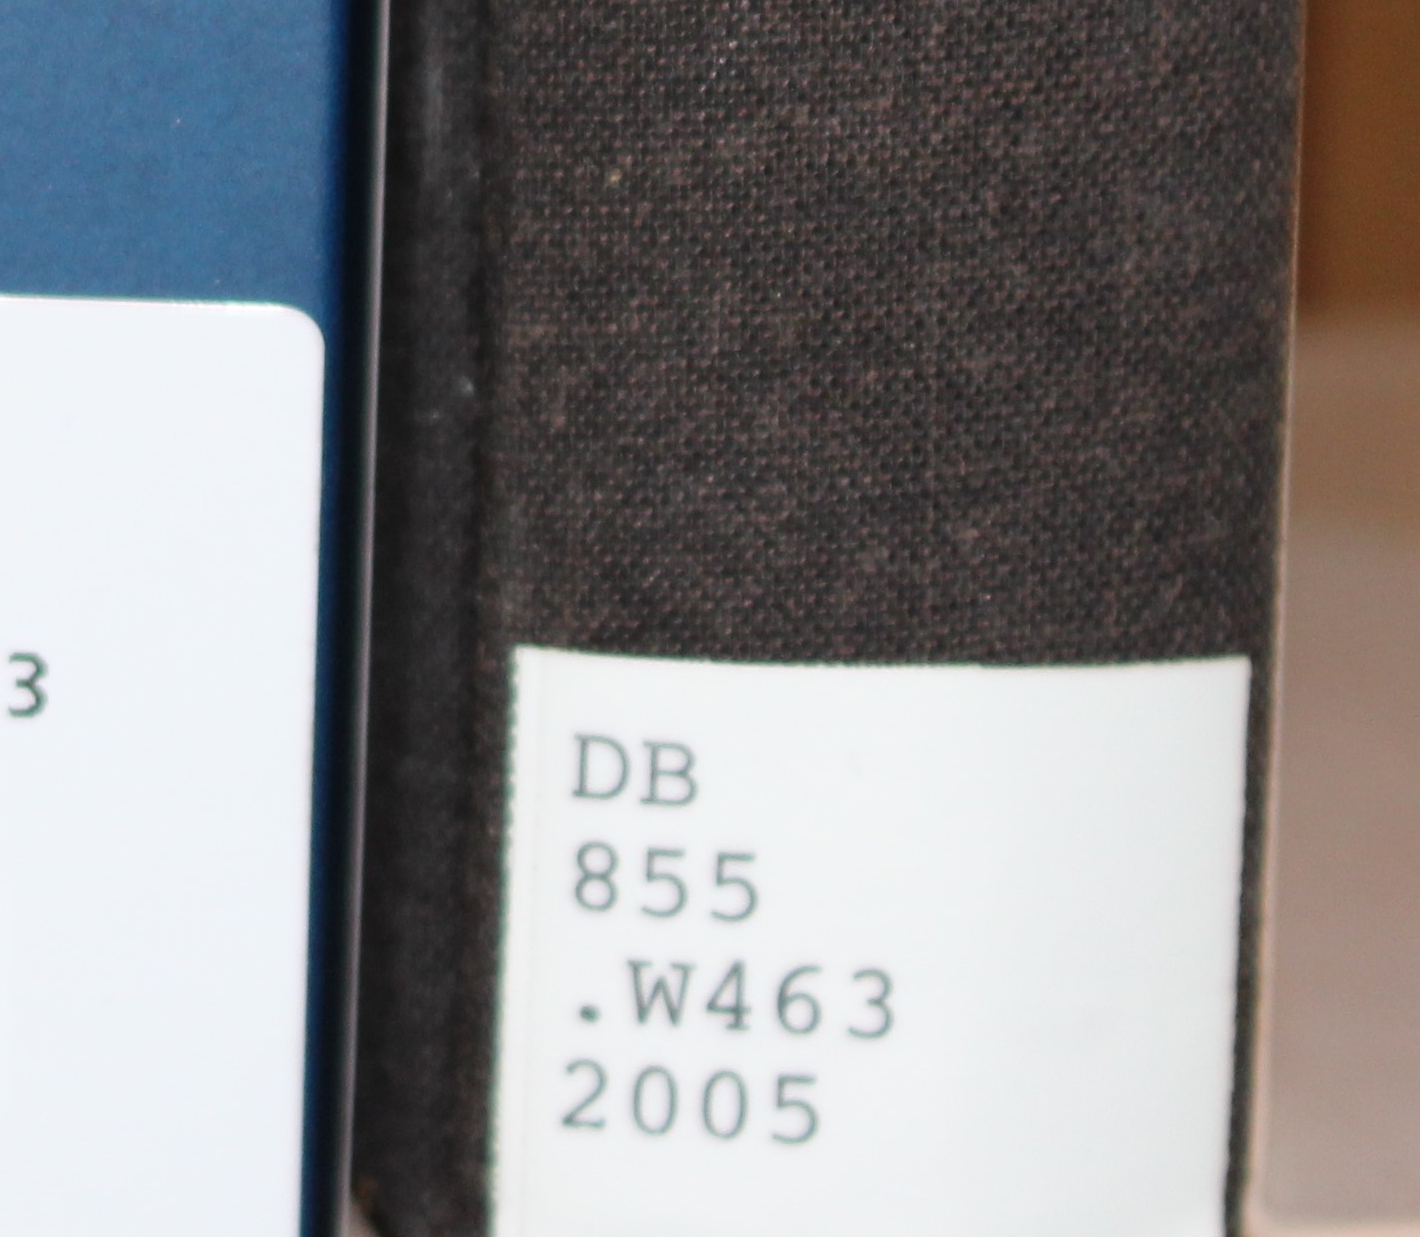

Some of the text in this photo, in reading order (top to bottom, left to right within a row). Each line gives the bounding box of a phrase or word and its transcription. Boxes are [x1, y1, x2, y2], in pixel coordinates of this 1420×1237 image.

[570, 732, 699, 808] DB
[572, 840, 759, 924] 855
[577, 958, 894, 1041] .W463
[560, 1058, 820, 1146] 2005
